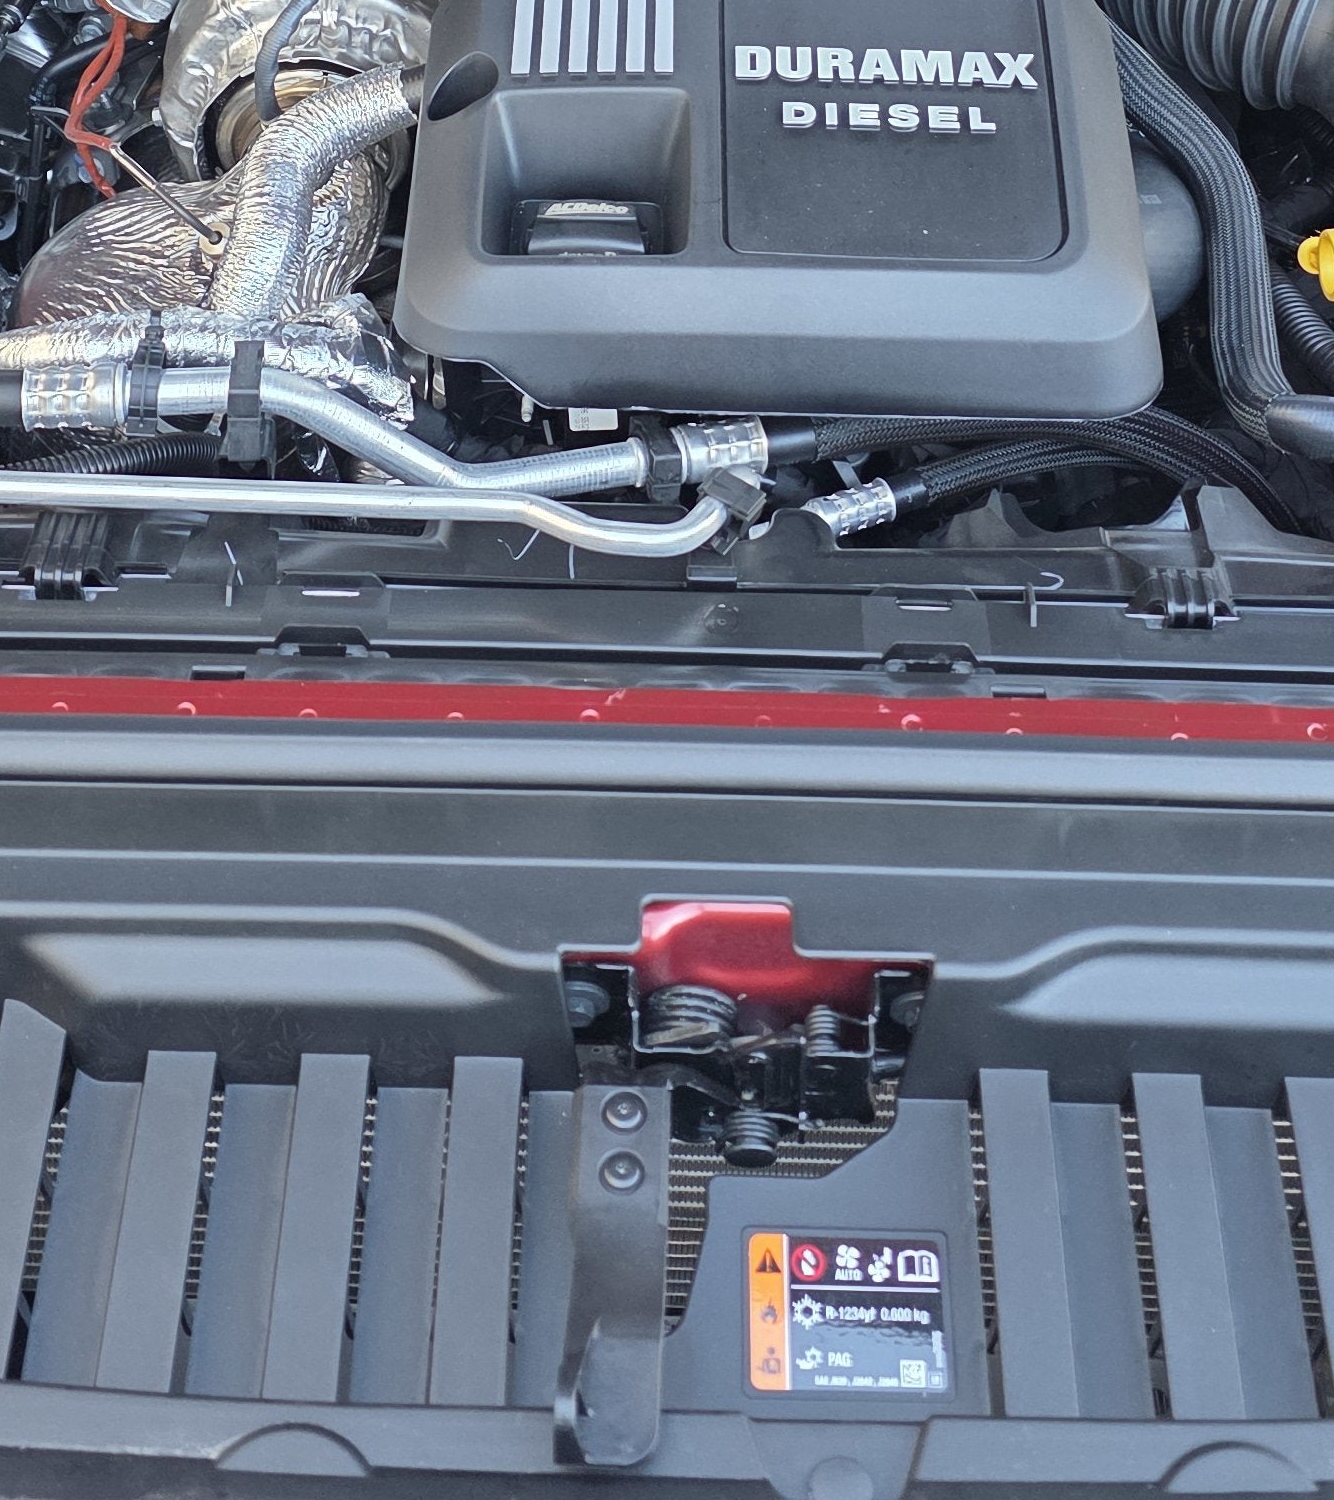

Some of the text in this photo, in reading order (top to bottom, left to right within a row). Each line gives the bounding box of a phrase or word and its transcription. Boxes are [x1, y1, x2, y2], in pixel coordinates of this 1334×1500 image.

[734, 45, 1038, 88] DURAMAX
[782, 101, 996, 133] DIESEL
[544, 202, 629, 216] ACDelco
[834, 1268, 863, 1281] AUTO
